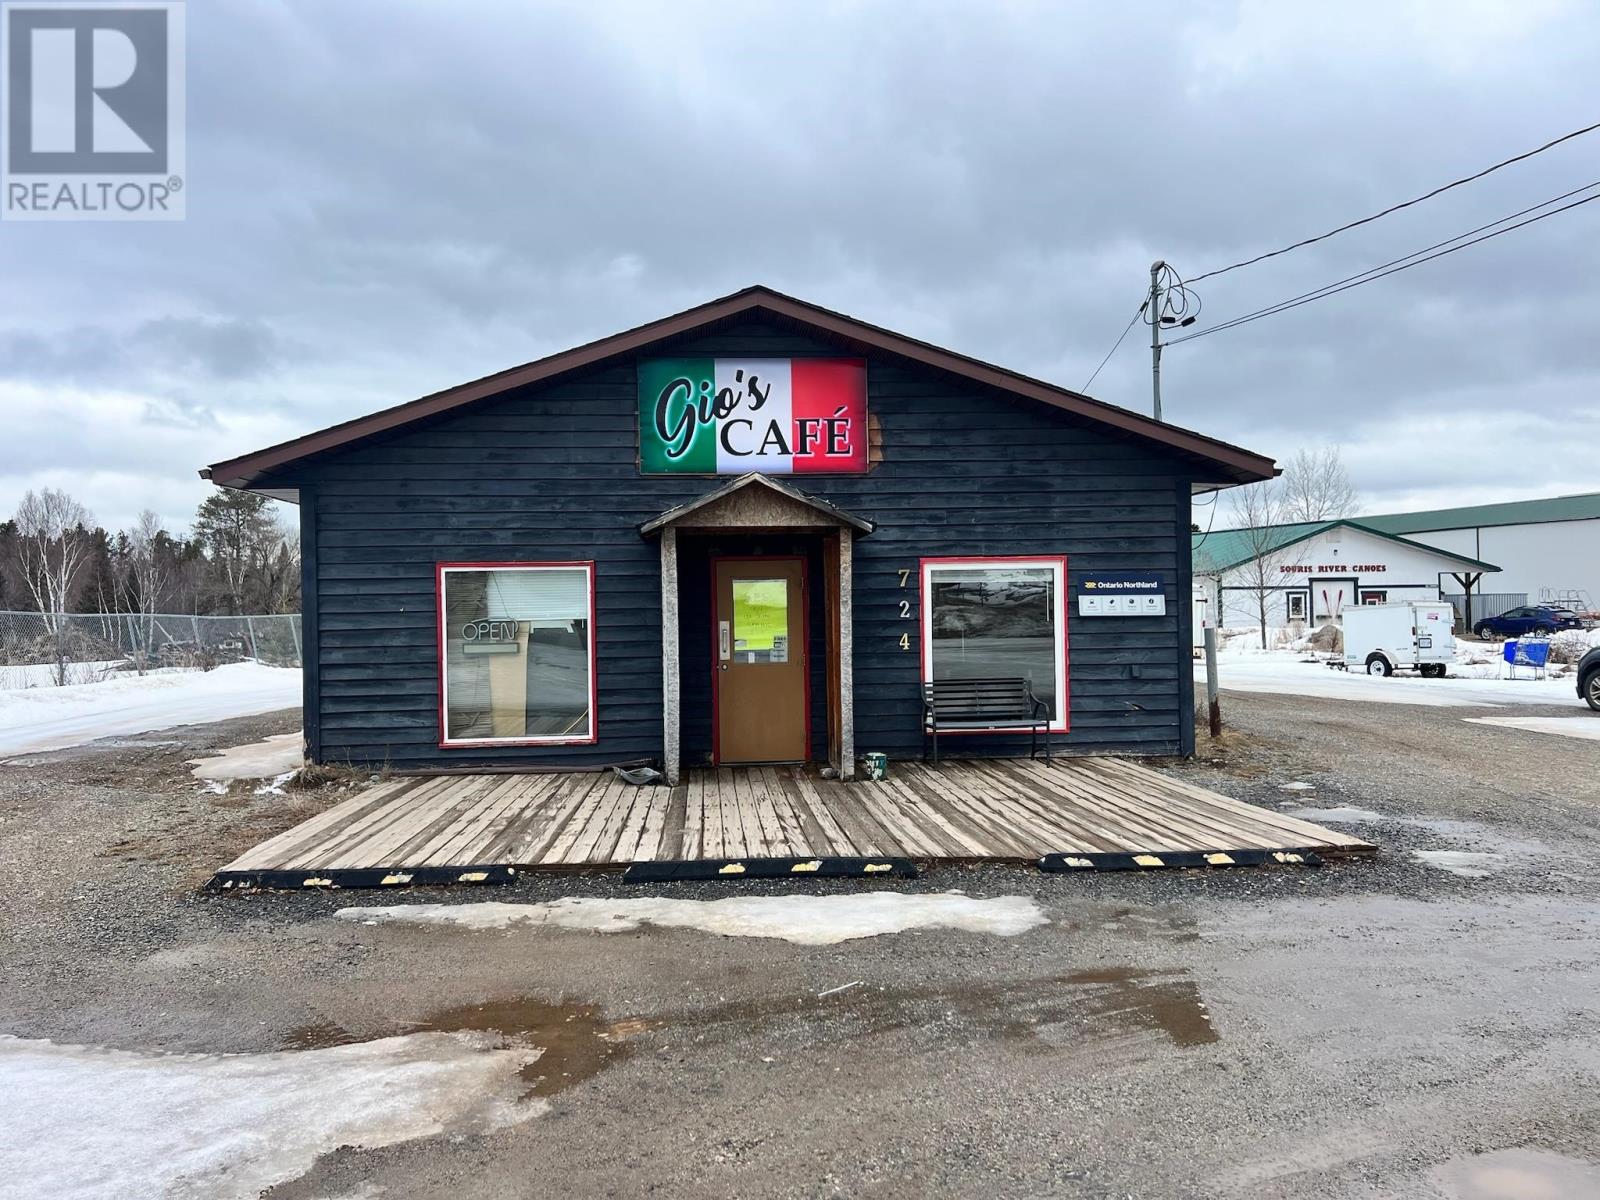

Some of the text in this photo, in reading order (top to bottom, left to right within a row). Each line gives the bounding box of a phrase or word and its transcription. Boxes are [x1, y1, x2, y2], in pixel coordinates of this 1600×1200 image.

[655, 369, 771, 458] Gio's
[720, 406, 853, 457] CAFÉ
[1280, 564, 1387, 573] SOURIS RIVER CANOES
[1097, 581, 1158, 589] Ontario Northland
[462, 622, 515, 640] OPEN
